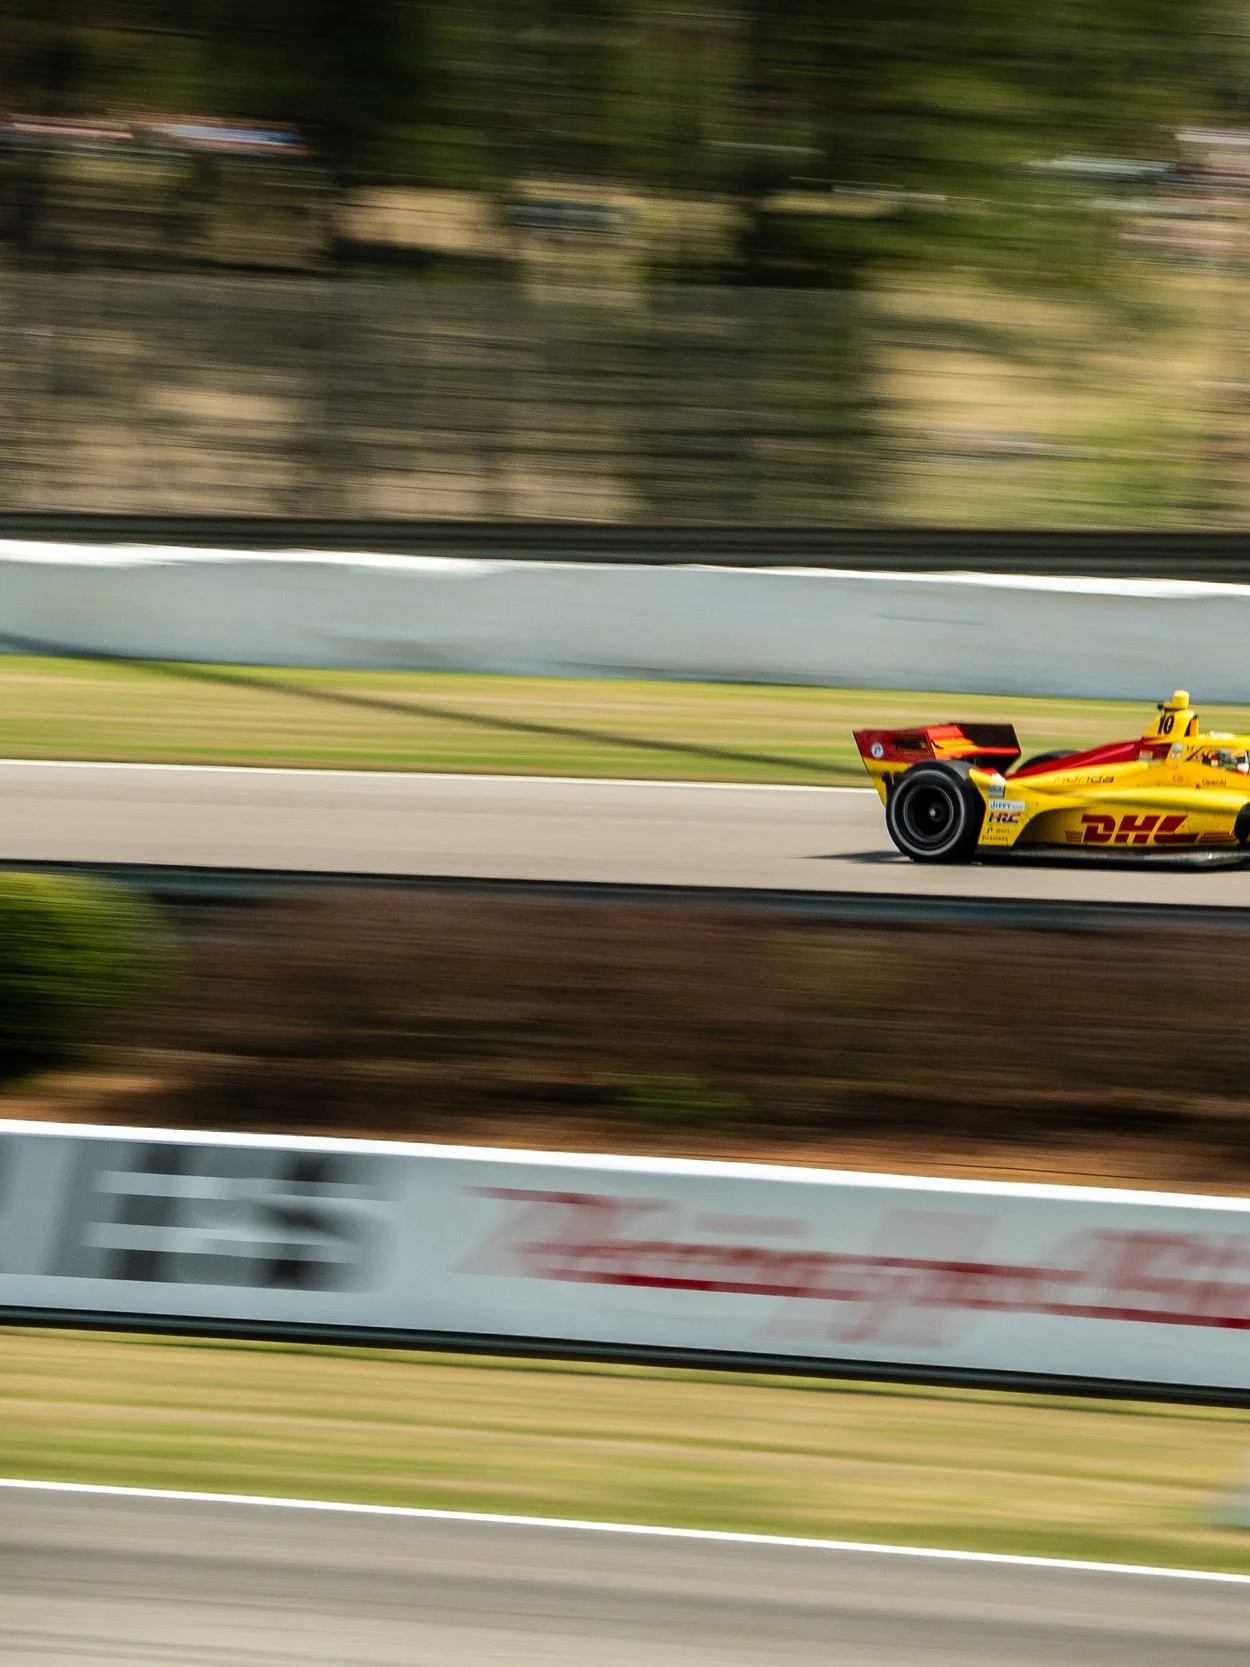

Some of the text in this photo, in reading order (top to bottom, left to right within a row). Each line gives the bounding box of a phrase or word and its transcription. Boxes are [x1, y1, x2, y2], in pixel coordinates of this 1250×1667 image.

[1157, 714, 1175, 735] 10
[1202, 777, 1226, 786] OpenAI
[989, 811, 1021, 824] HRC
[1080, 814, 1199, 844] DHL
